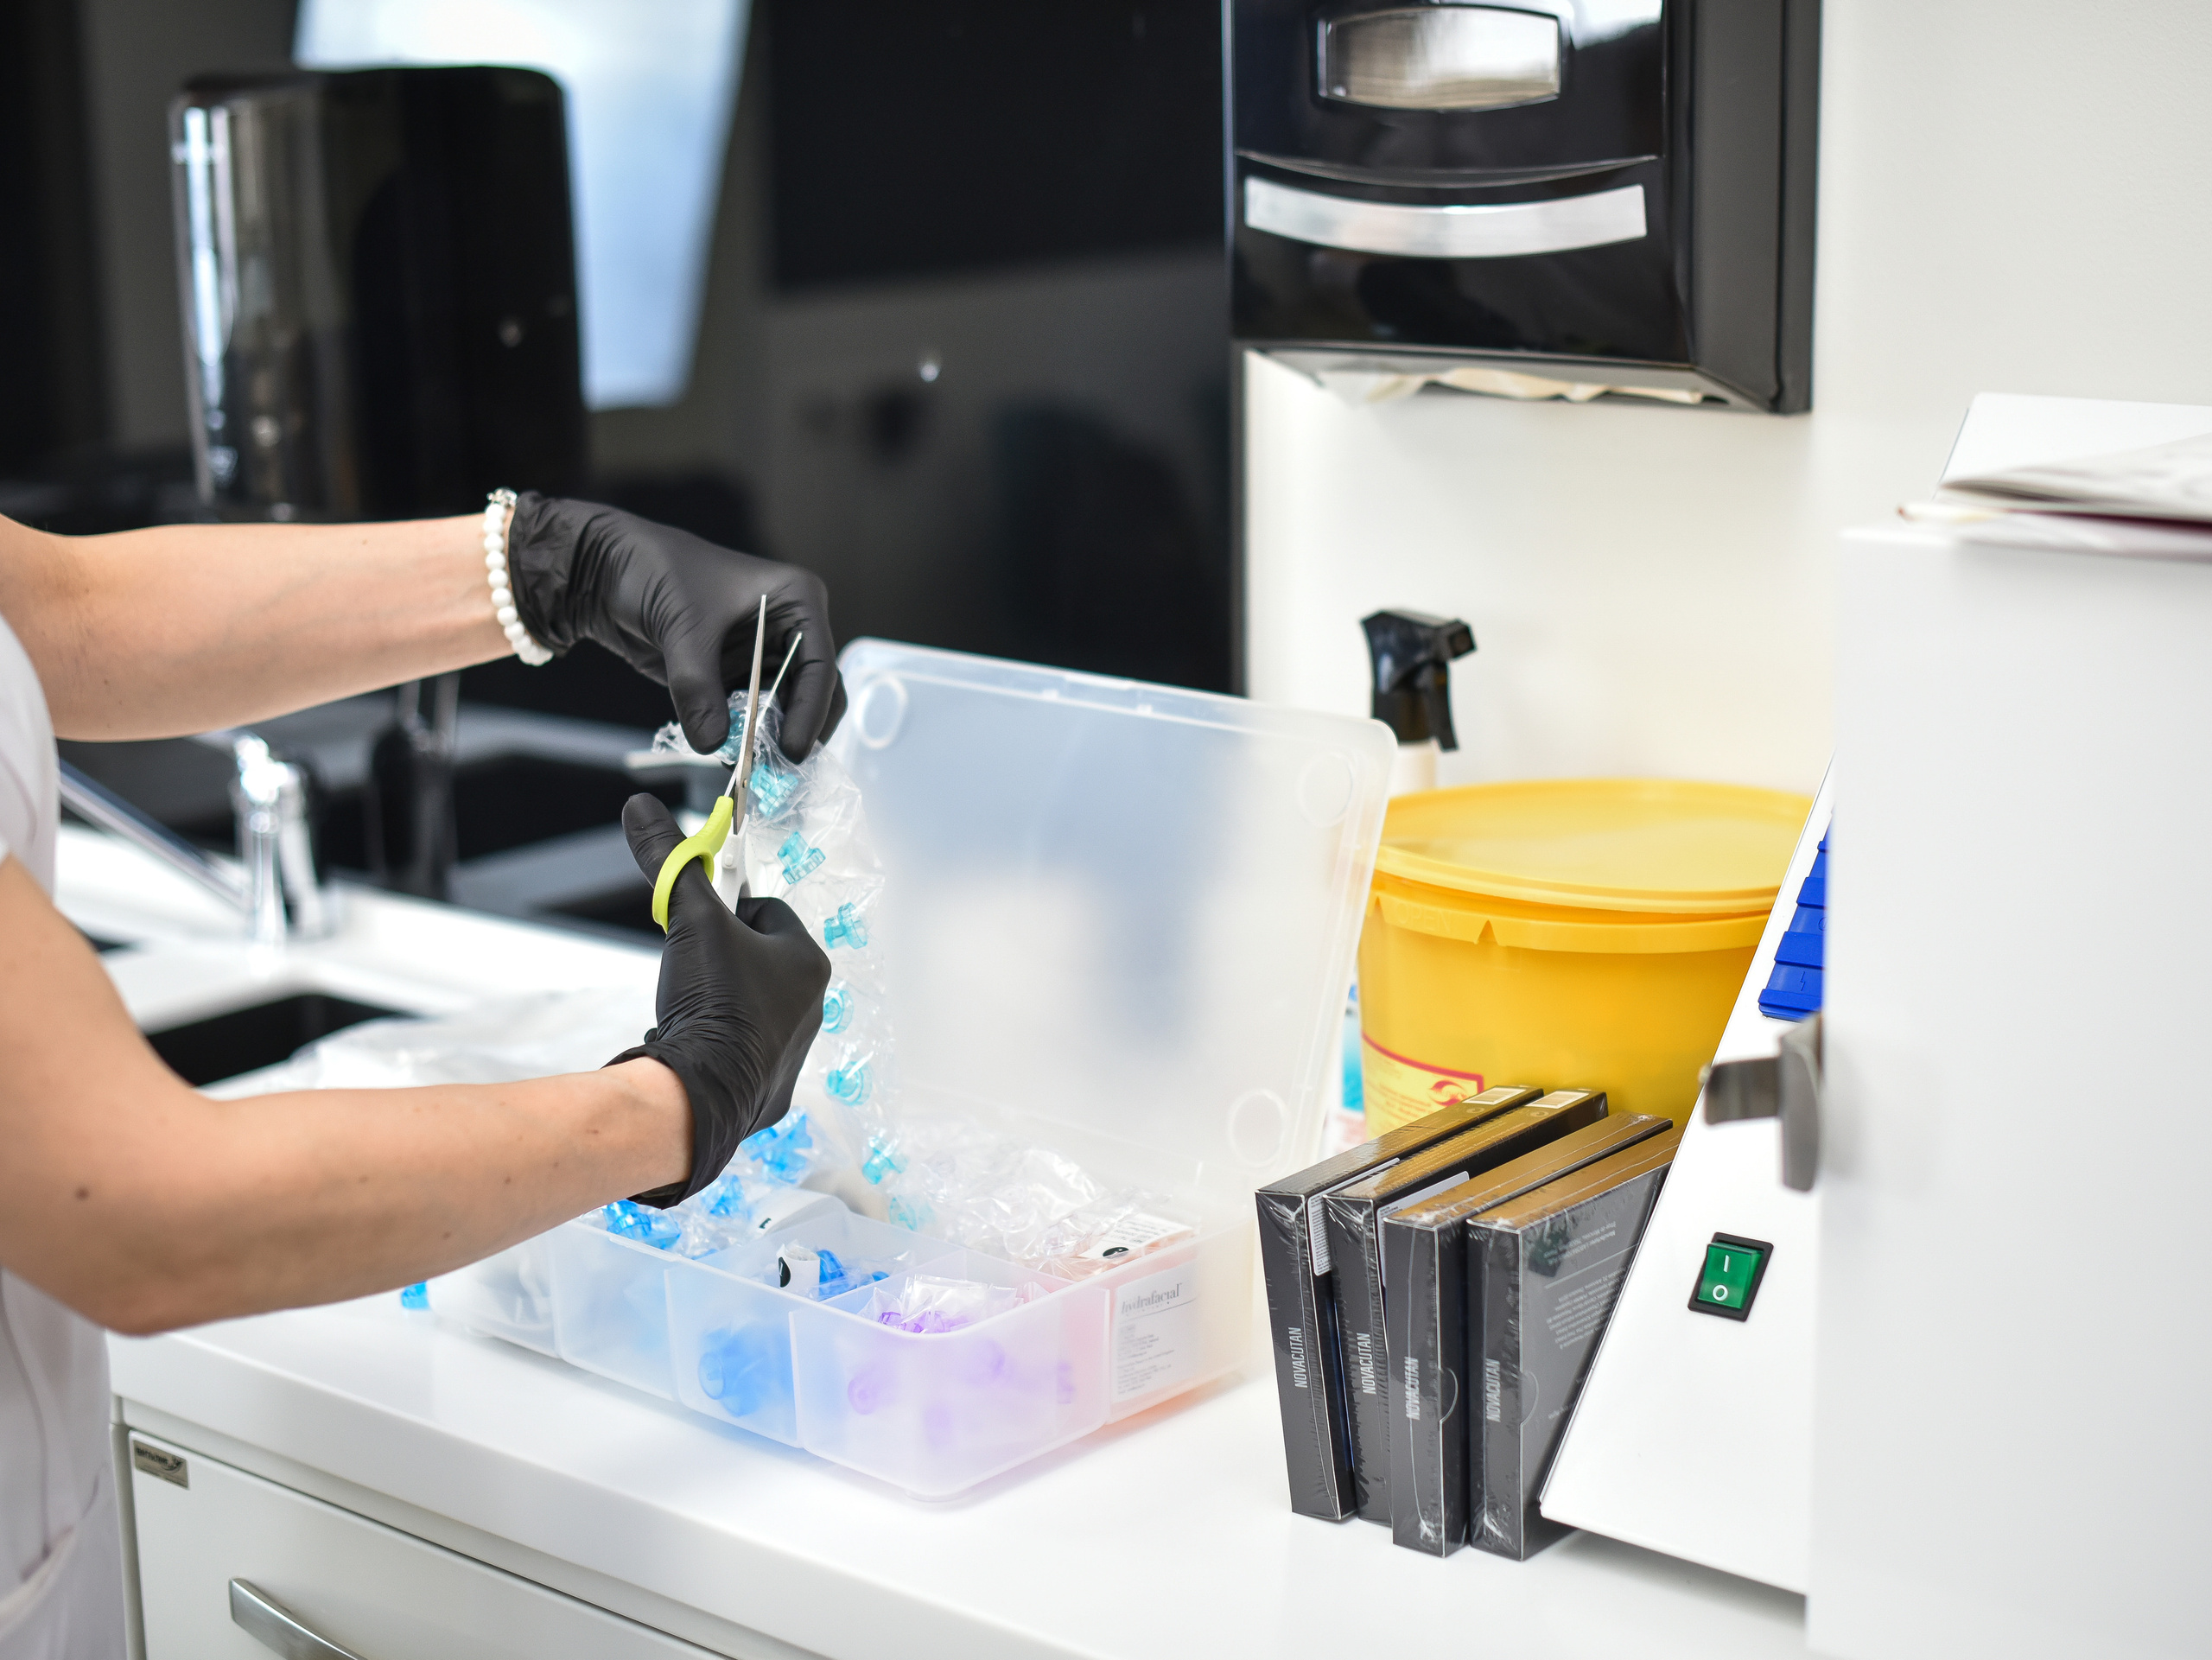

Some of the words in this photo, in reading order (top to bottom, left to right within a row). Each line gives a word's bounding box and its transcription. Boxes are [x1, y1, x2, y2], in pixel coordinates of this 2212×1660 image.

[1287, 1326, 1308, 1389] NOVACUTAN
[1356, 1332, 1376, 1395] NOVACUTAN
[1404, 1356, 1421, 1421] NOVACUTAN
[1484, 1358, 1502, 1423] NOVACUTAN
